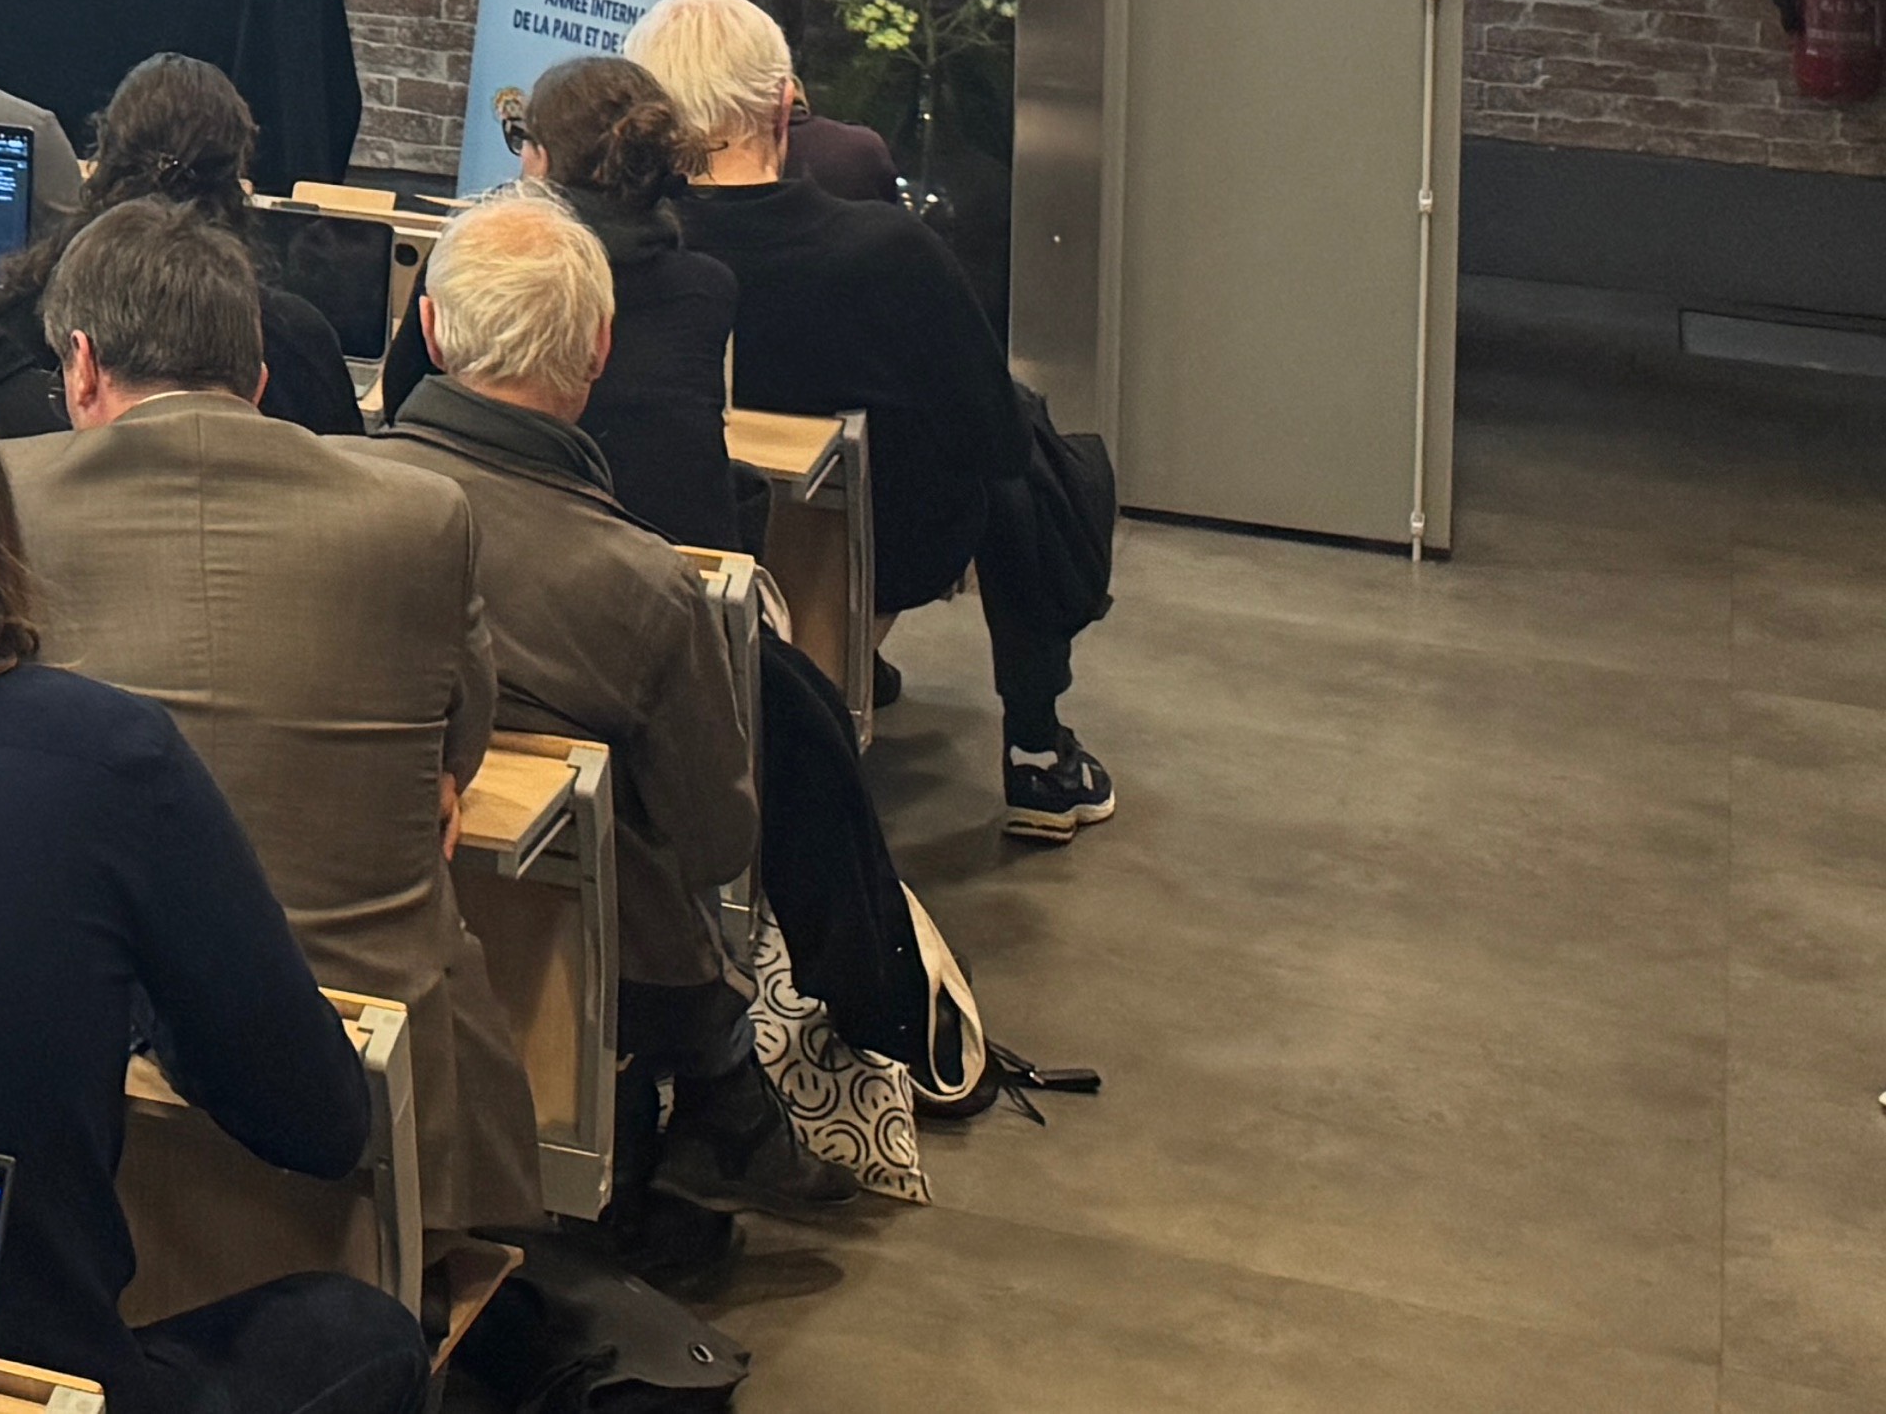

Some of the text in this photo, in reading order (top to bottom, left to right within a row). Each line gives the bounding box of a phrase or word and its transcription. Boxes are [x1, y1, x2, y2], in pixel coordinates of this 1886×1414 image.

[513, 8, 532, 30] DE
[533, 13, 549, 35] LA
[552, 17, 582, 45] PAIX
[584, 26, 599, 48] ET
[602, 30, 620, 53] DE
